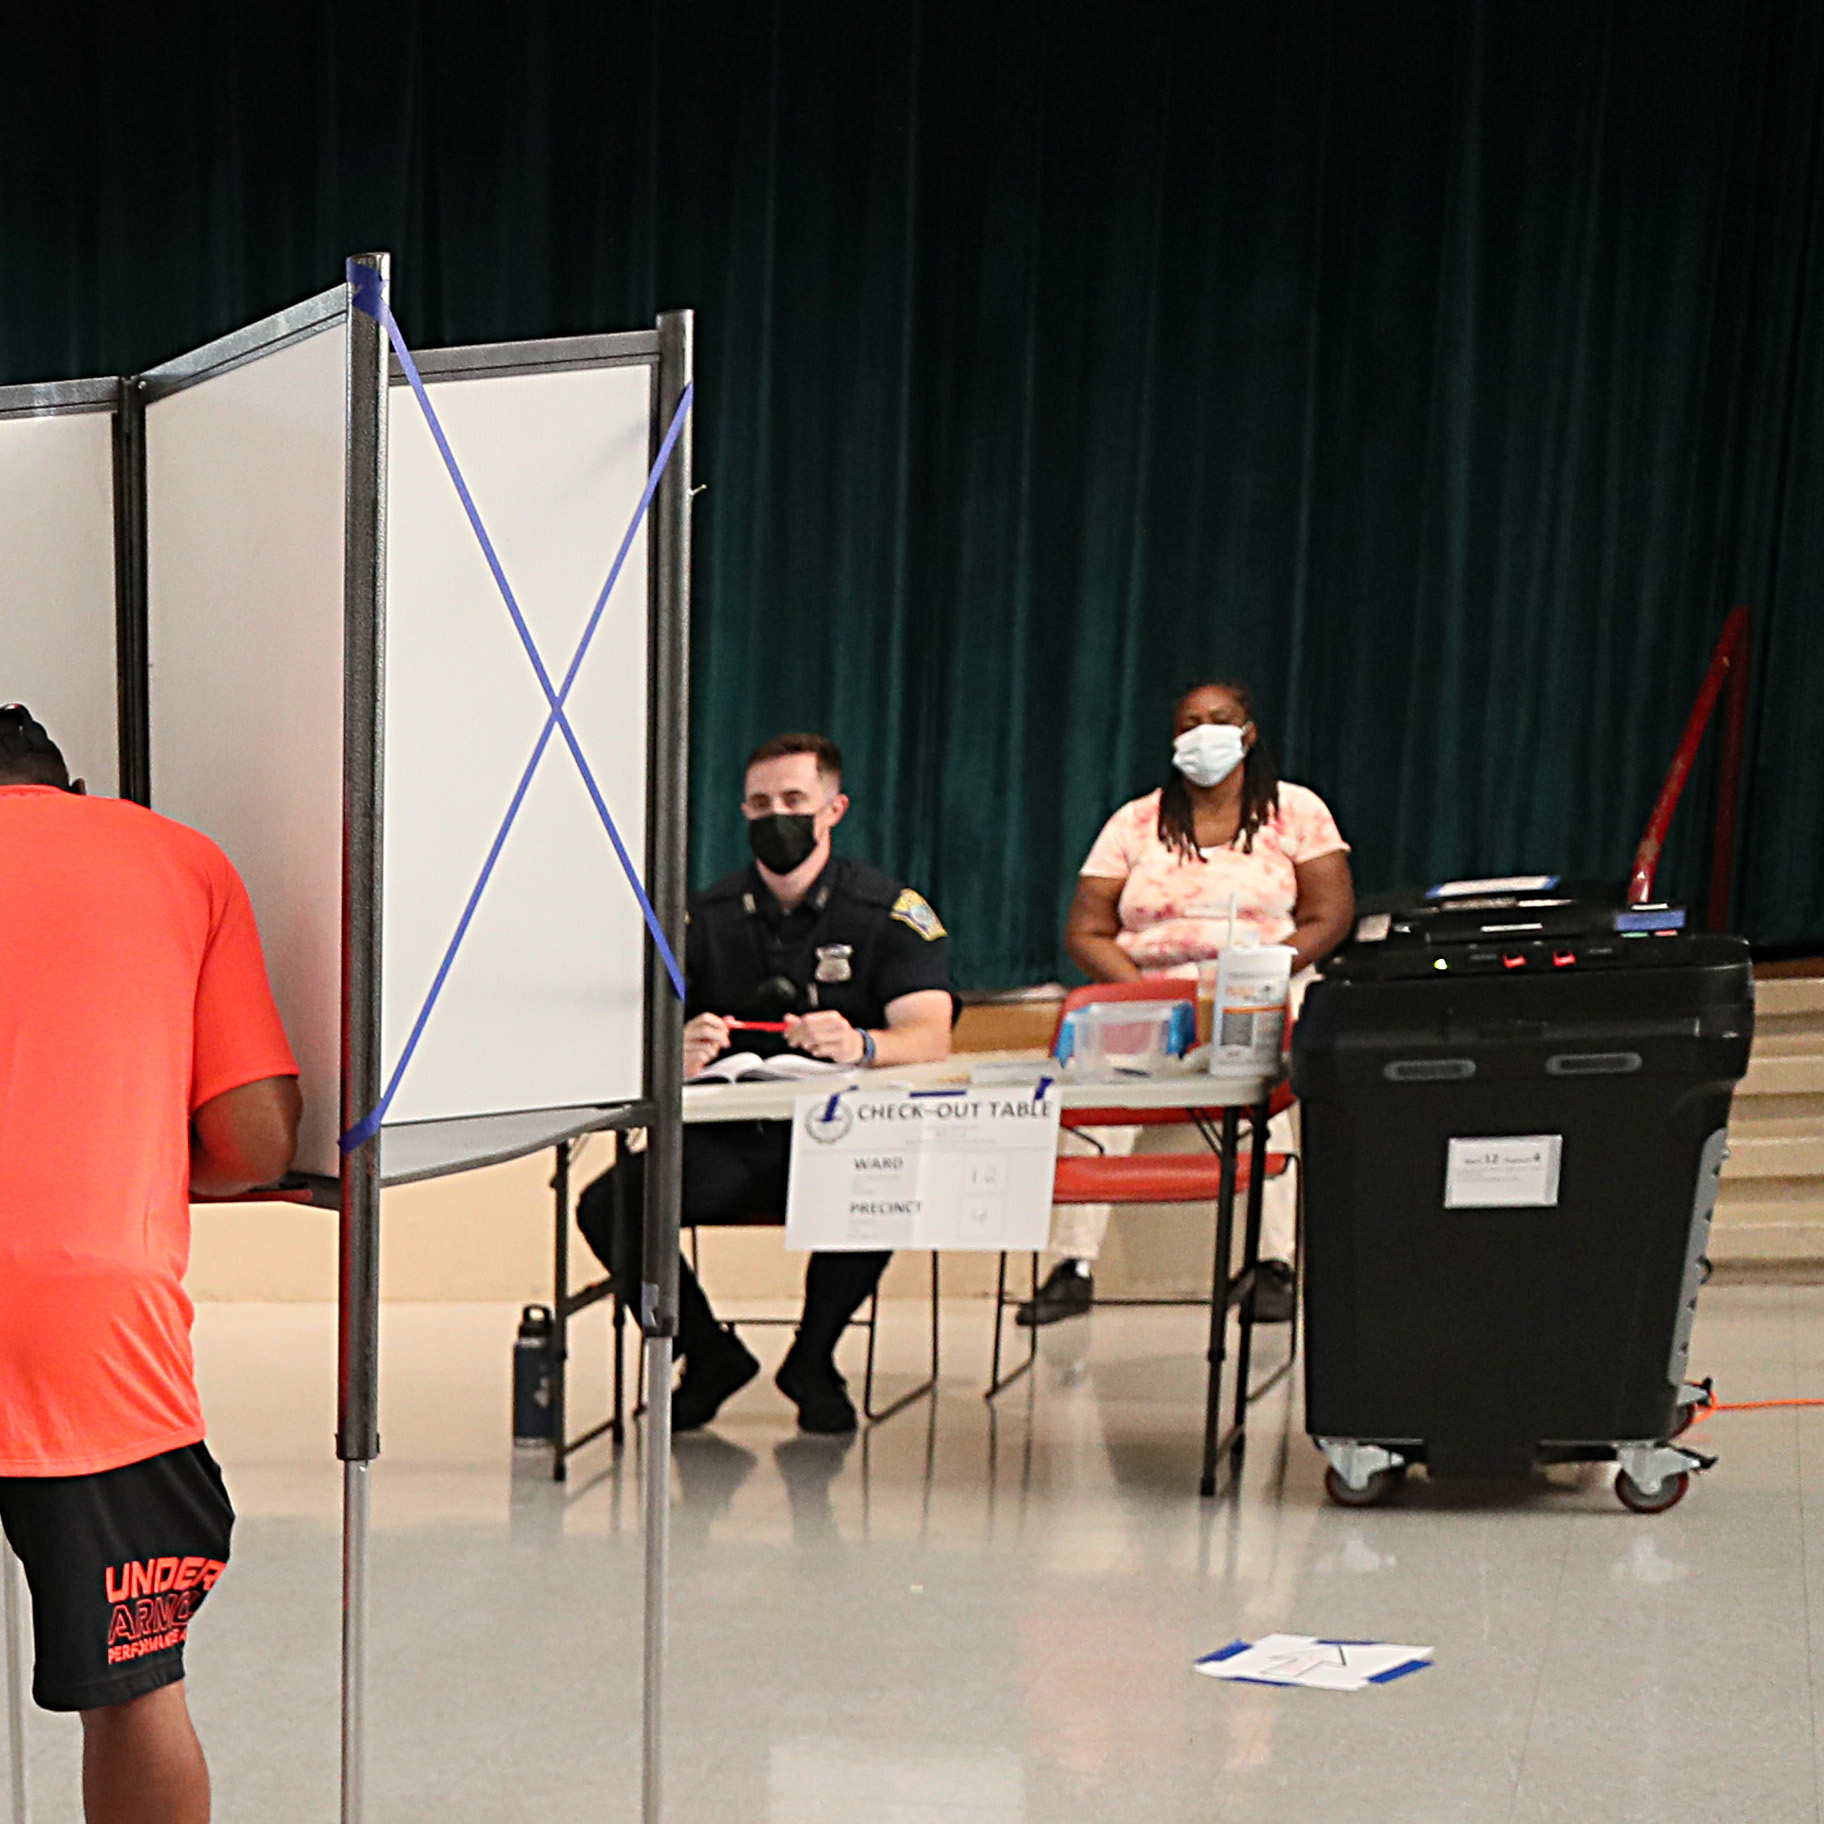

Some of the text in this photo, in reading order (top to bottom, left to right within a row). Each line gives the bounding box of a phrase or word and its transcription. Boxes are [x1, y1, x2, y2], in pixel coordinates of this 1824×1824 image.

[858, 1100, 1051, 1121] CHECK-OUT TABLE
[854, 1156, 904, 1171] WARD
[850, 1200, 921, 1216] PRECINCT
[105, 1556, 227, 1604] UNDER
